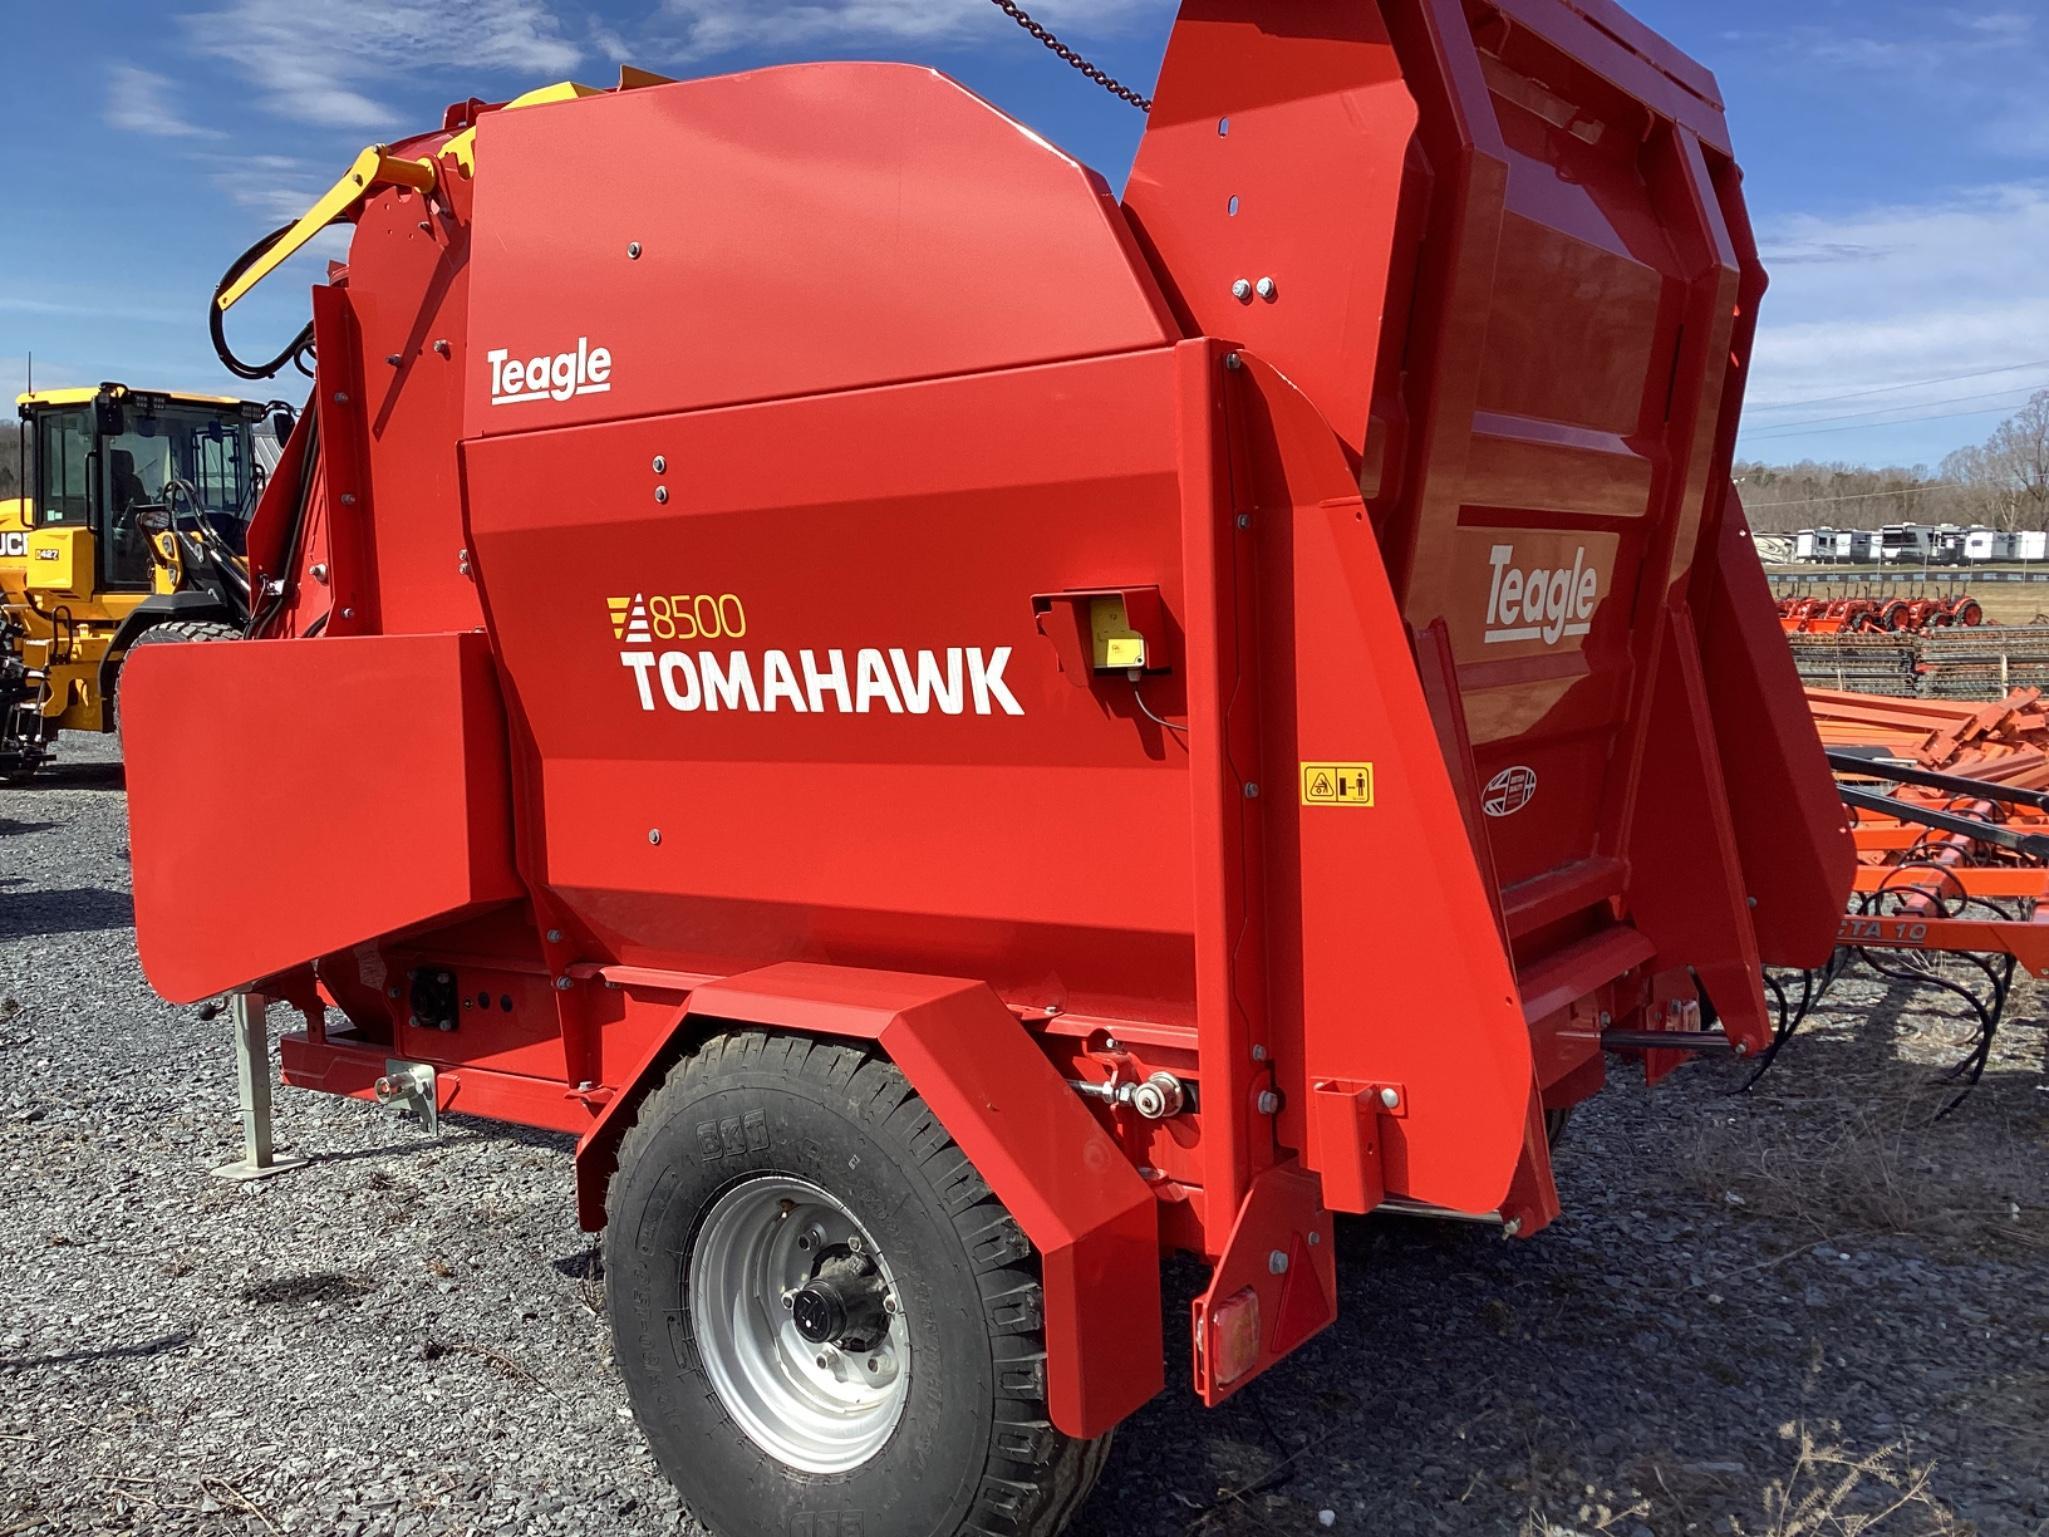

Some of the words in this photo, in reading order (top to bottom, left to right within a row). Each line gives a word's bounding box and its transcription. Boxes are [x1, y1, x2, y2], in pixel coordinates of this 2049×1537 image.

[487, 336, 611, 403] Teagle
[649, 593, 747, 640] 8500
[1485, 544, 1597, 645] Teagle
[619, 646, 1026, 716] TOMAHAWK
[1896, 922, 1927, 939] 10
